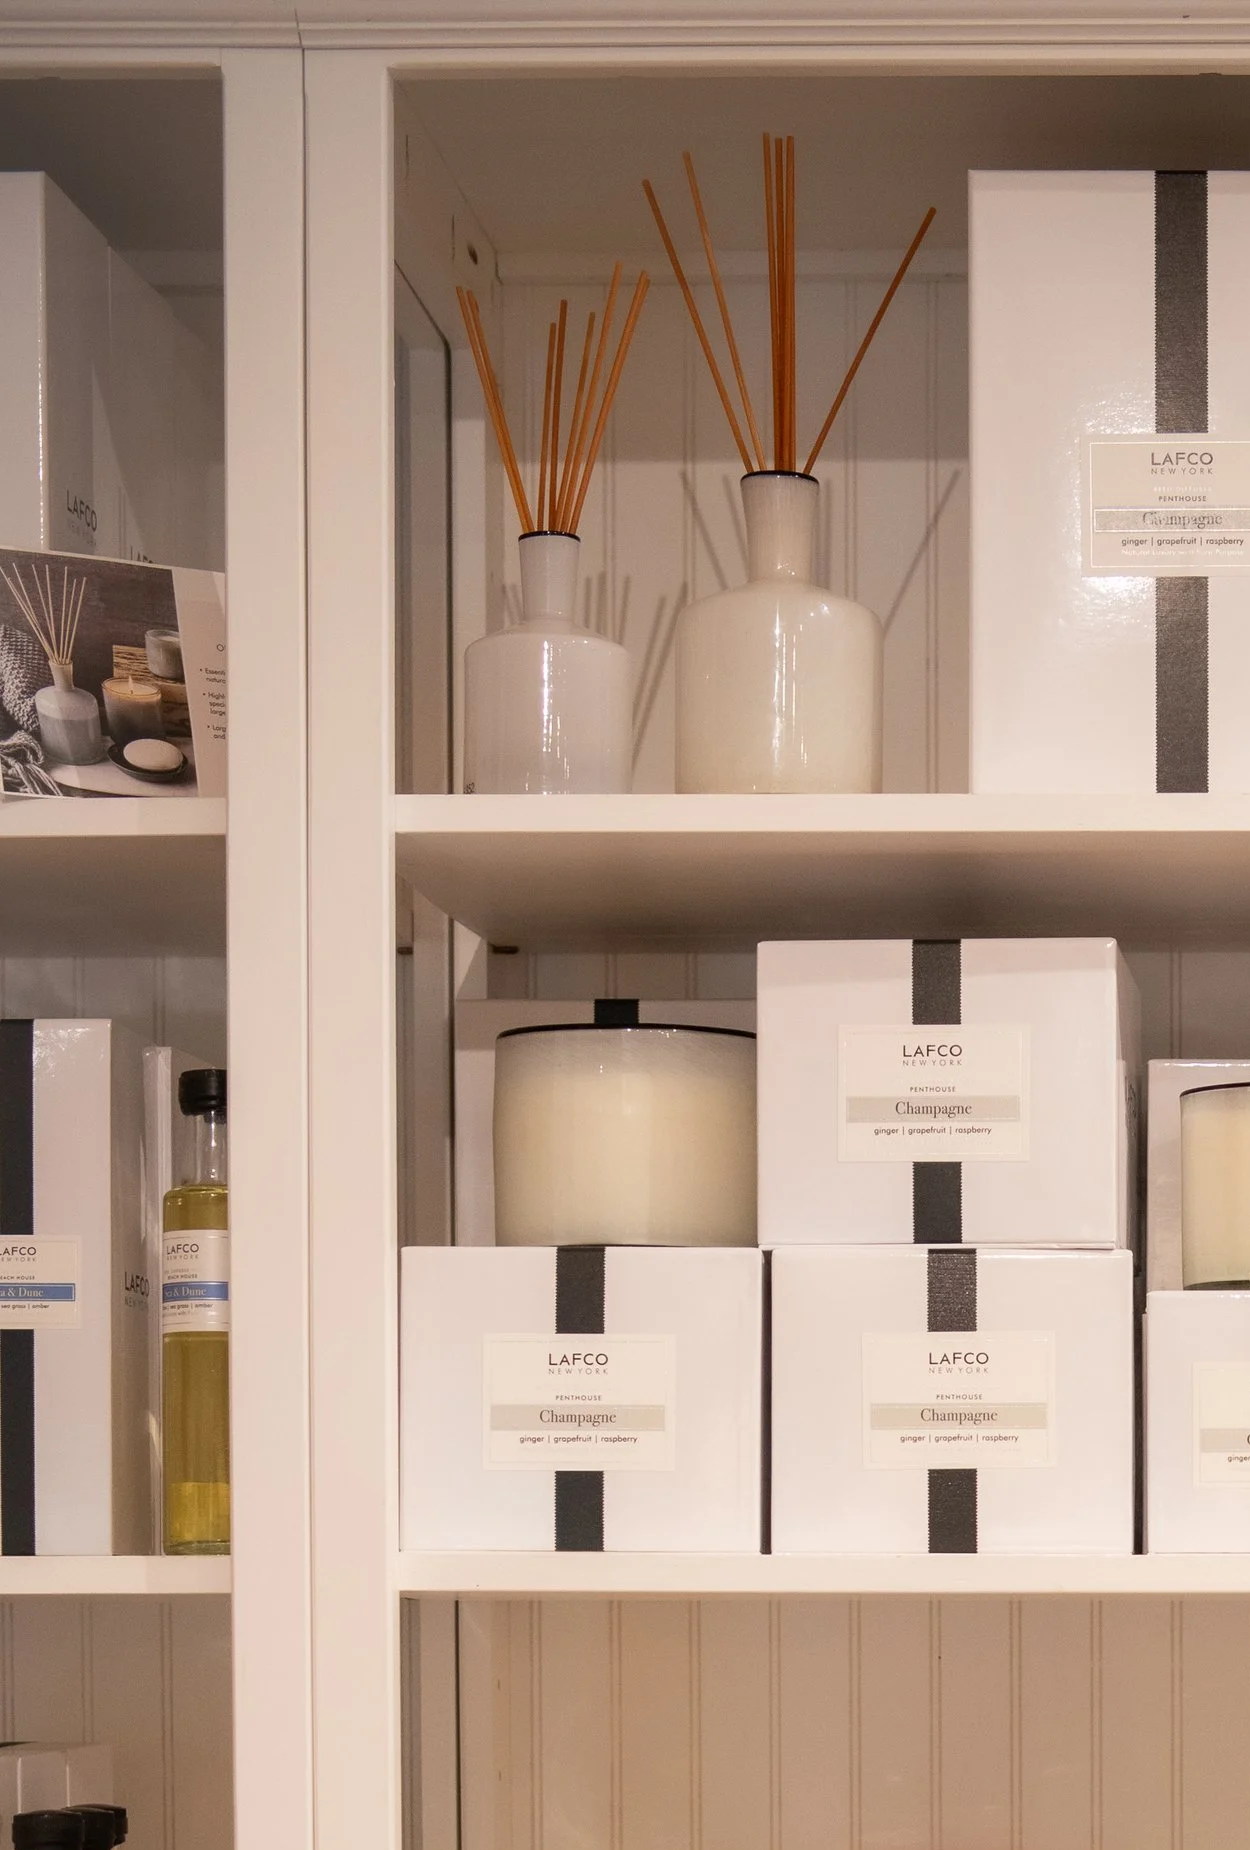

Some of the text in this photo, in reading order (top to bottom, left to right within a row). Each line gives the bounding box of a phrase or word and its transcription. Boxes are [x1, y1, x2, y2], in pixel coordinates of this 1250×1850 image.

[1151, 452, 1213, 465] LAFCO
[67, 489, 97, 532] LAFCO
[1122, 537, 1244, 546] ginger grapefruit raspberry
[903, 1045, 962, 1057] LAFCO
[895, 1101, 972, 1118] Champagne
[874, 1127, 992, 1135] ginger grapefruit raspberry
[167, 1243, 199, 1255] LAFCO
[125, 1271, 149, 1298] LAFCO
[7, 1287, 44, 1297] & Dune
[182, 1287, 207, 1296] Dune
[549, 1353, 608, 1365] LAFCO
[929, 1352, 989, 1365] LAFCO
[539, 1409, 617, 1426] Champagne
[920, 1408, 998, 1425] Champagne
[520, 1435, 637, 1443] ginger grapefruit raspberry
[900, 1434, 1019, 1443] ginger grapefruit raspberry
[1228, 1454, 1250, 1462] ginger
